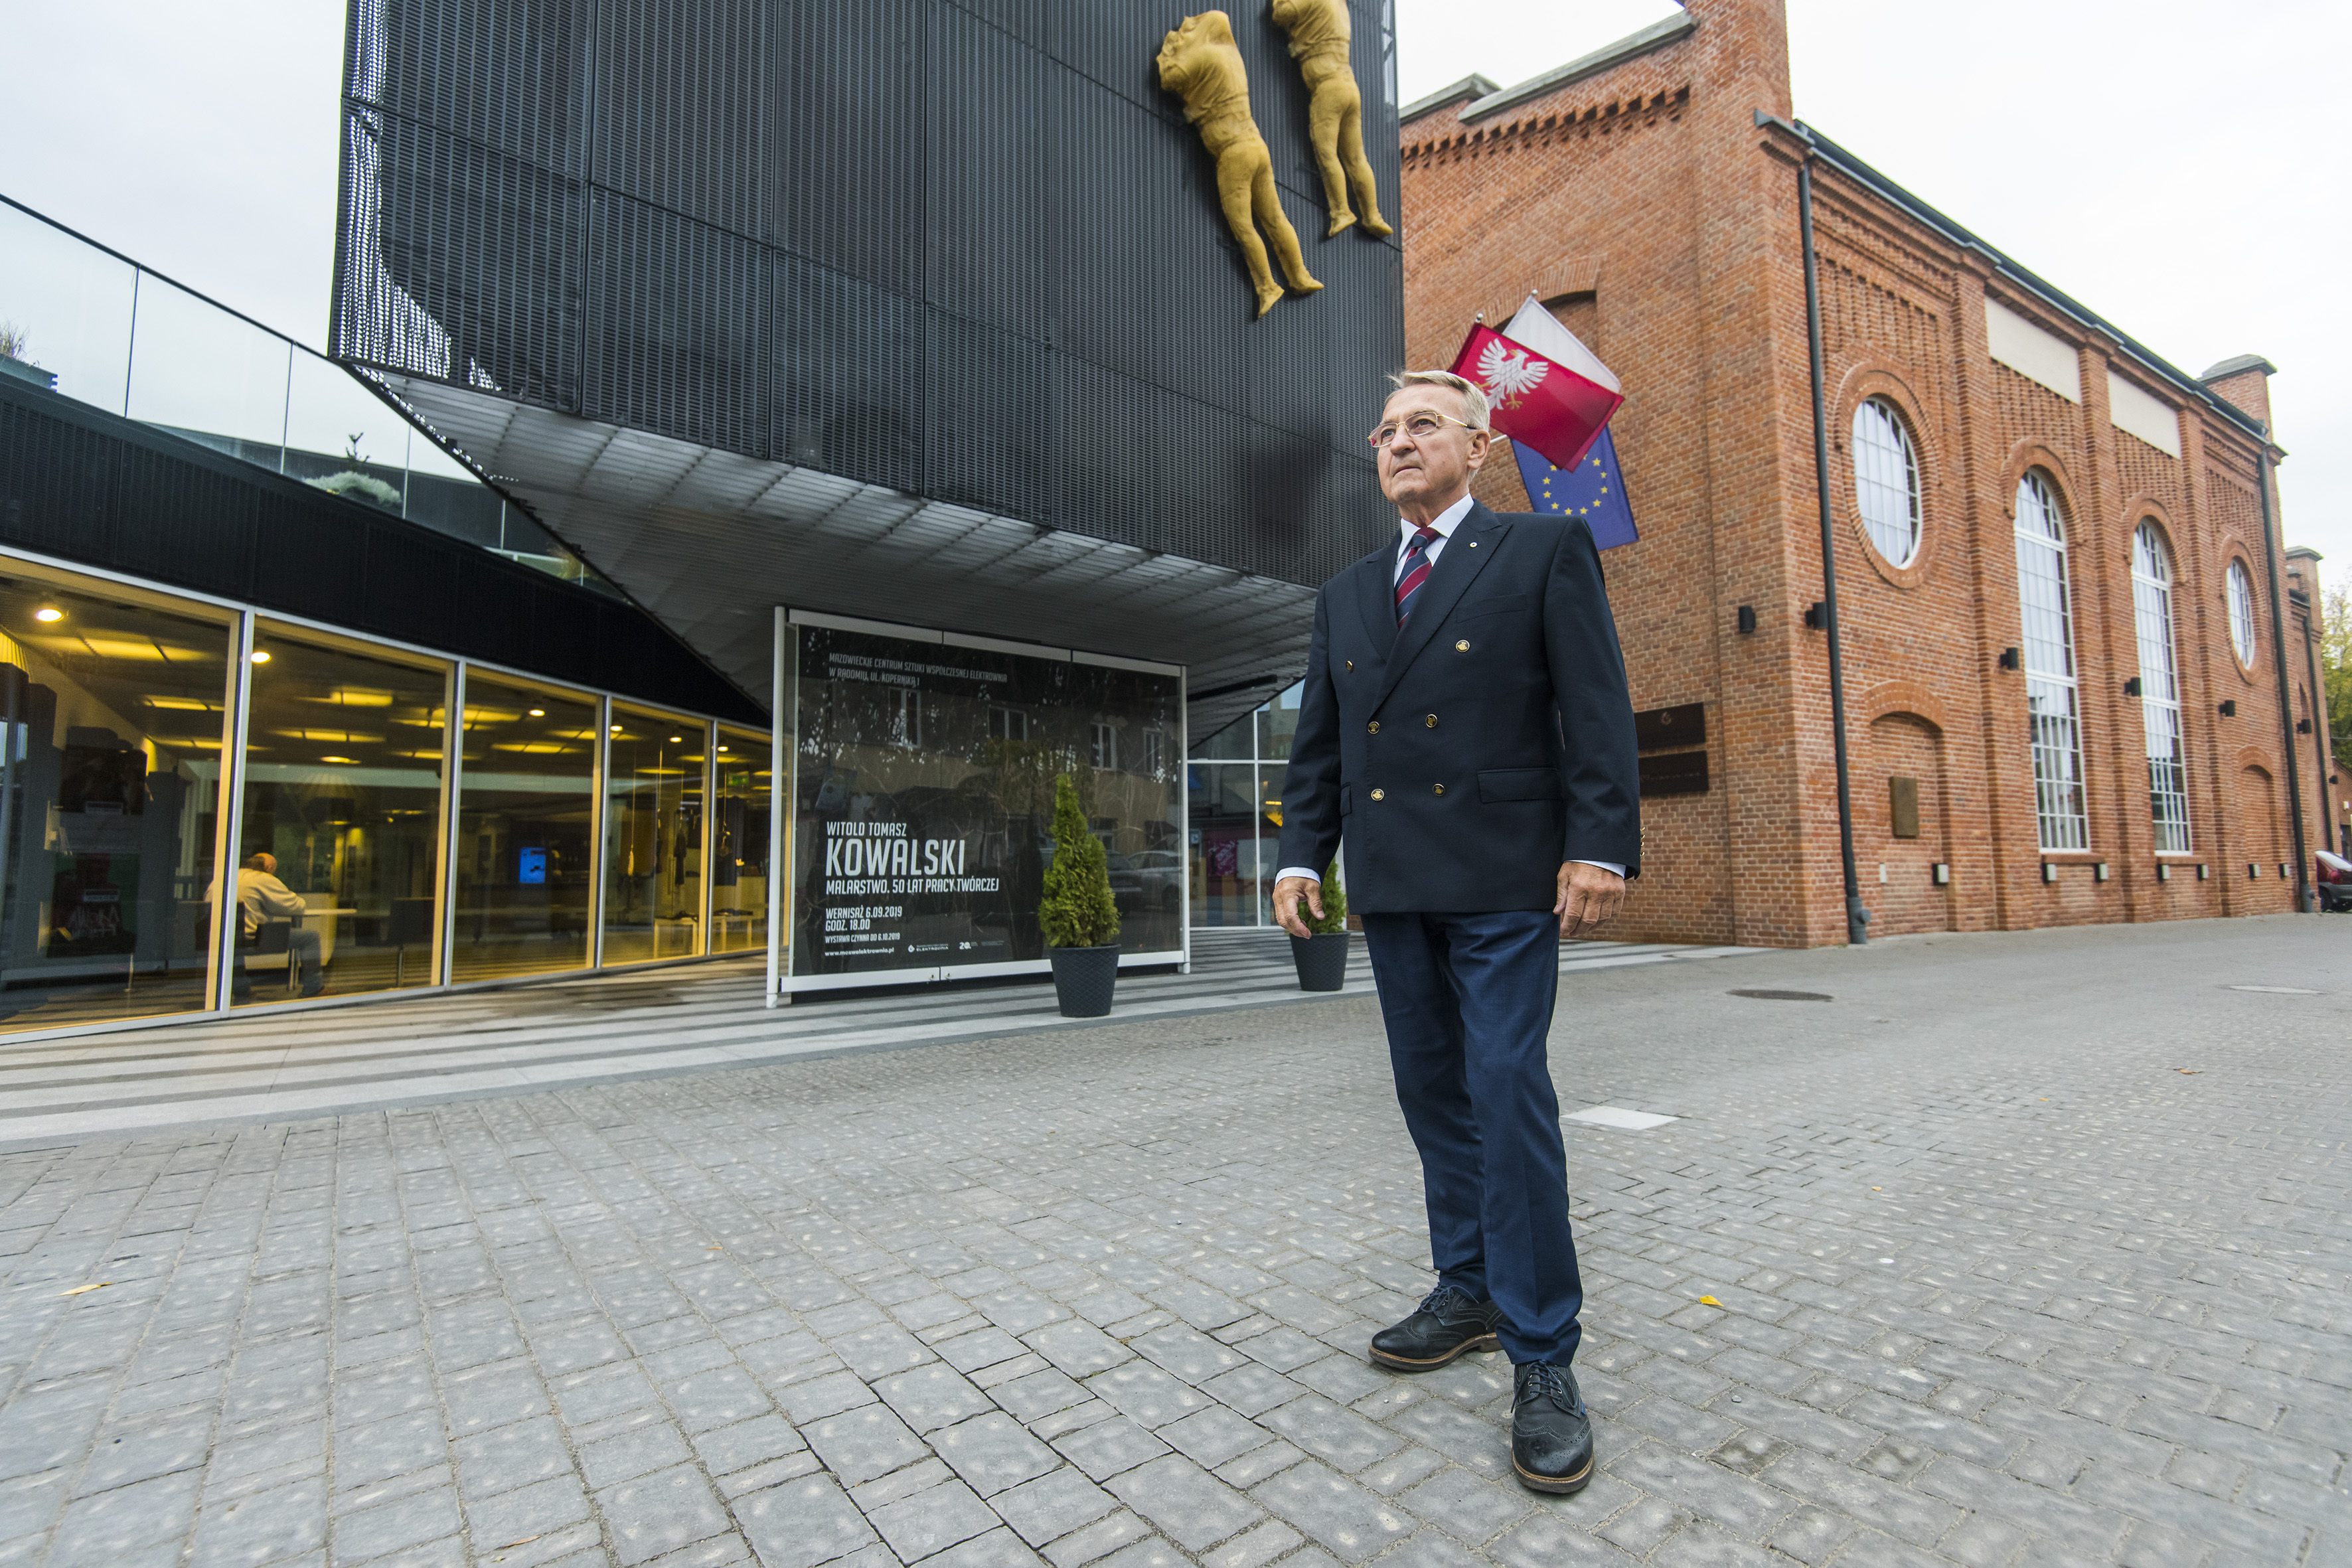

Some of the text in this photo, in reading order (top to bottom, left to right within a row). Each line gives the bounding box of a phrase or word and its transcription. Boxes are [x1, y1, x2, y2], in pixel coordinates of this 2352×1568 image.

[829, 653, 873, 667] MAZOWIECKIE
[874, 658, 903, 670] CENTRUM
[904, 662, 925, 673] SZTUKI
[970, 670, 1007, 682] ELEKTROWNIA
[829, 667, 836, 676] W
[881, 672, 915, 686] KOPERNIKA
[826, 821, 907, 836] WITOLD TOMASZ
[826, 838, 965, 876] KOWALSKI
[826, 876, 1000, 895] MALARSTWO. 50 LAT PRACY TWÓRCZEJ
[826, 905, 902, 919] WERNISAŻ 6.09.2019
[825, 919, 870, 931] GODZ. 18.00
[825, 935, 850, 943] WYSTAWA
[850, 933, 870, 942] CZYNNA
[878, 932, 900, 941] 6.10.2019
